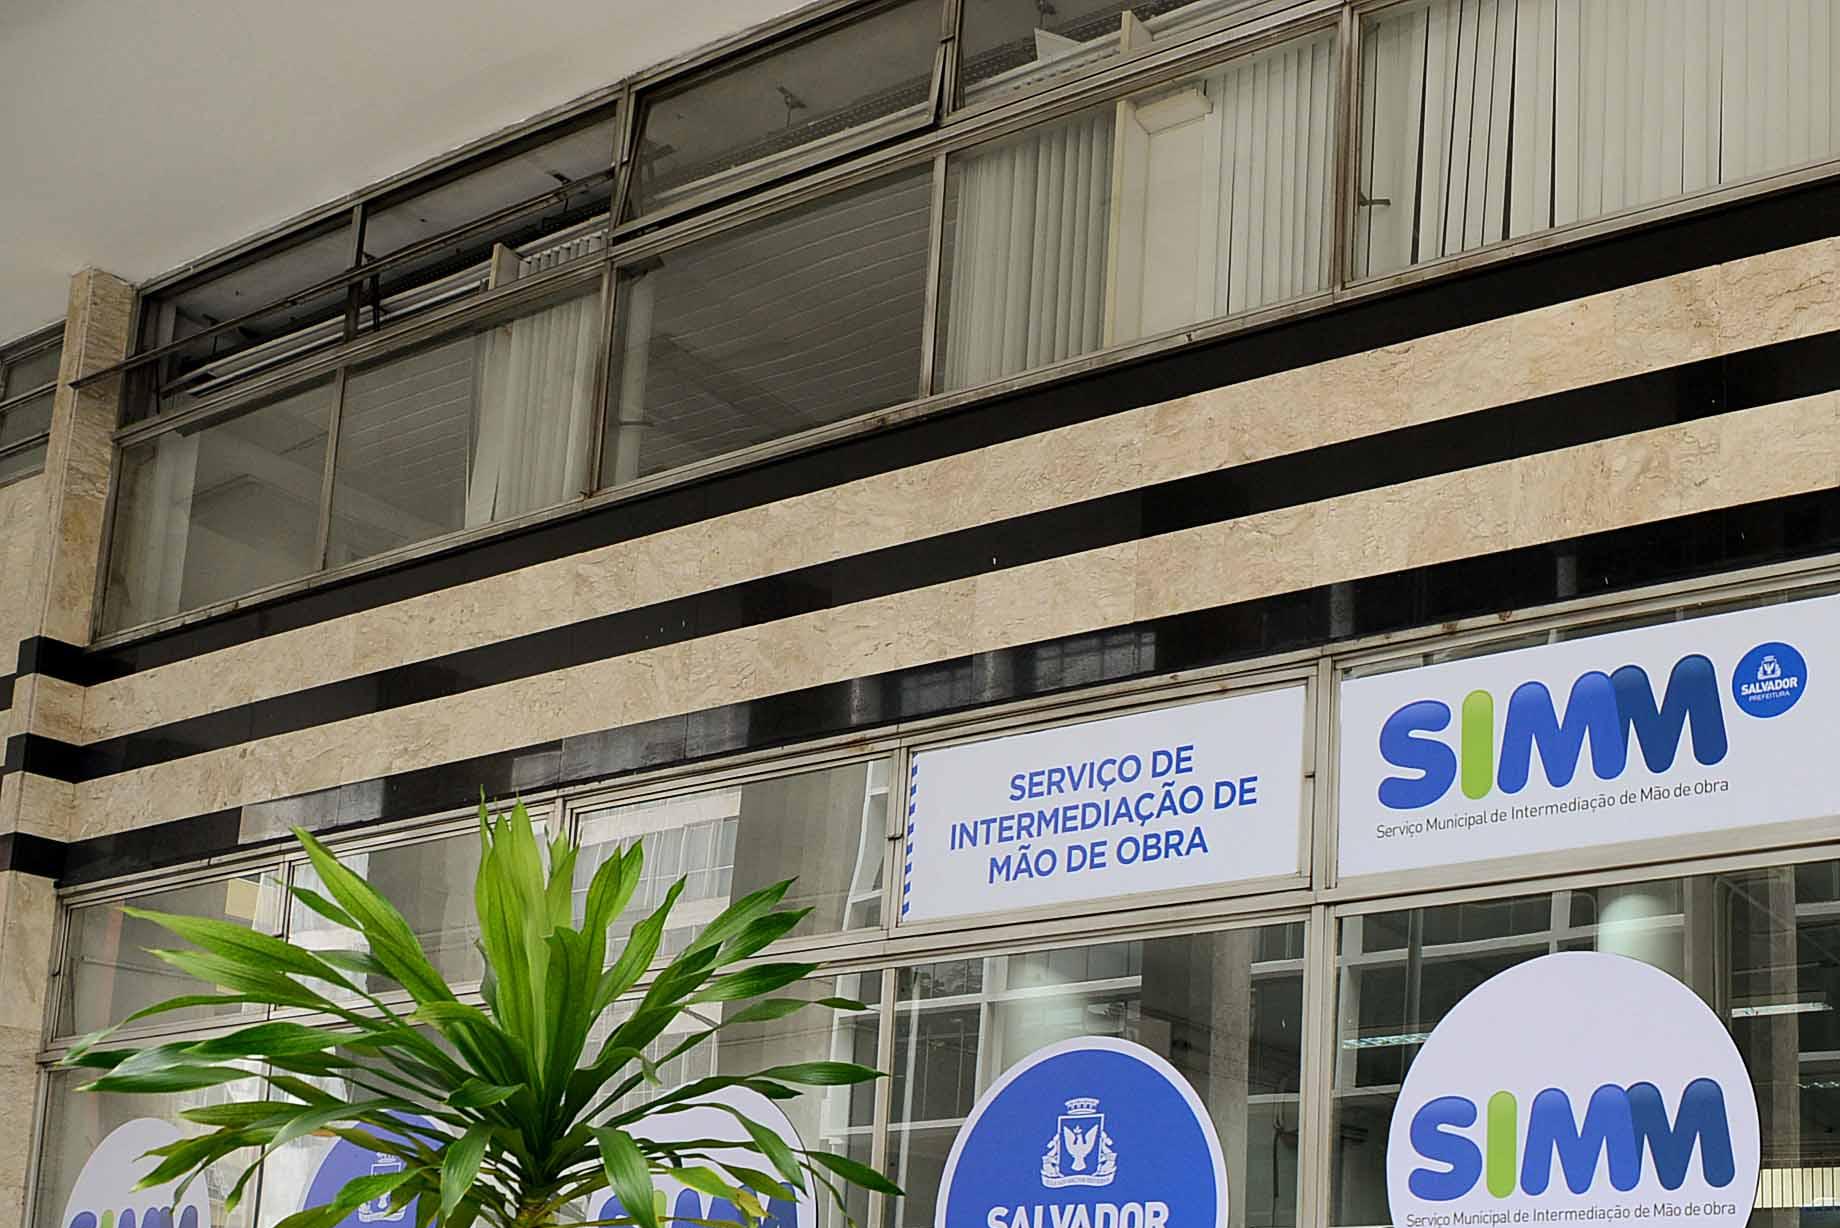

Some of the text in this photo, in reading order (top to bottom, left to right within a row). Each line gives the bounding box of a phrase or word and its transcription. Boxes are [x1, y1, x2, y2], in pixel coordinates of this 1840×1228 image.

[1741, 677, 1798, 695] SALVADOR
[1378, 653, 1729, 810] SIMM
[1009, 745, 1194, 801] SERVIÇO DE
[950, 776, 1258, 850] INTERMEDIAÇÃO DE
[1376, 778, 1729, 839] Serviço Municipal de Intermediação de Mão de Obra
[988, 826, 1209, 884] MÃO DE OBRA
[1408, 1077, 1736, 1202] SIMM
[1407, 1200, 1737, 1228] Serviço Municipal de Intermediação de Mão de Obra
